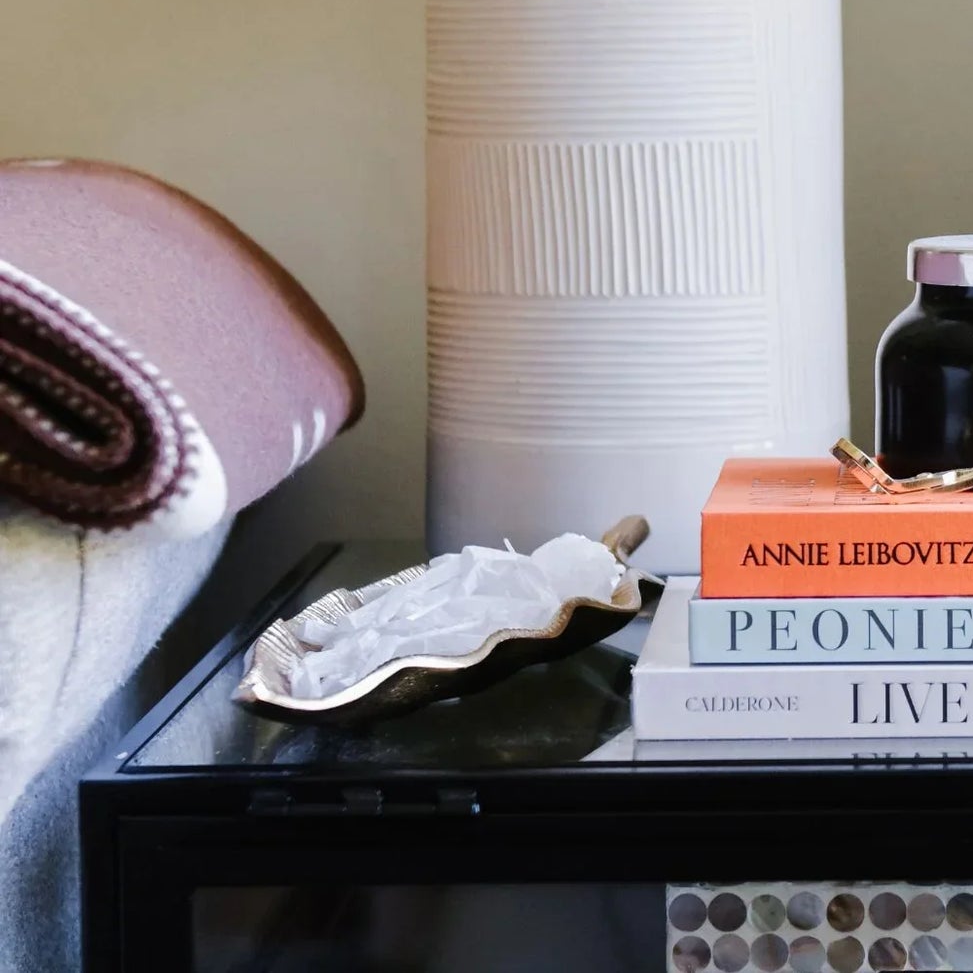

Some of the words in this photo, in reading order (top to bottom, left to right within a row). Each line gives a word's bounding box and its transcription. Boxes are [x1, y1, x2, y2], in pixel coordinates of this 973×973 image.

[740, 542, 829, 567] ANNIE
[685, 695, 799, 713] CALDERONE
[849, 681, 969, 724] LIVE
